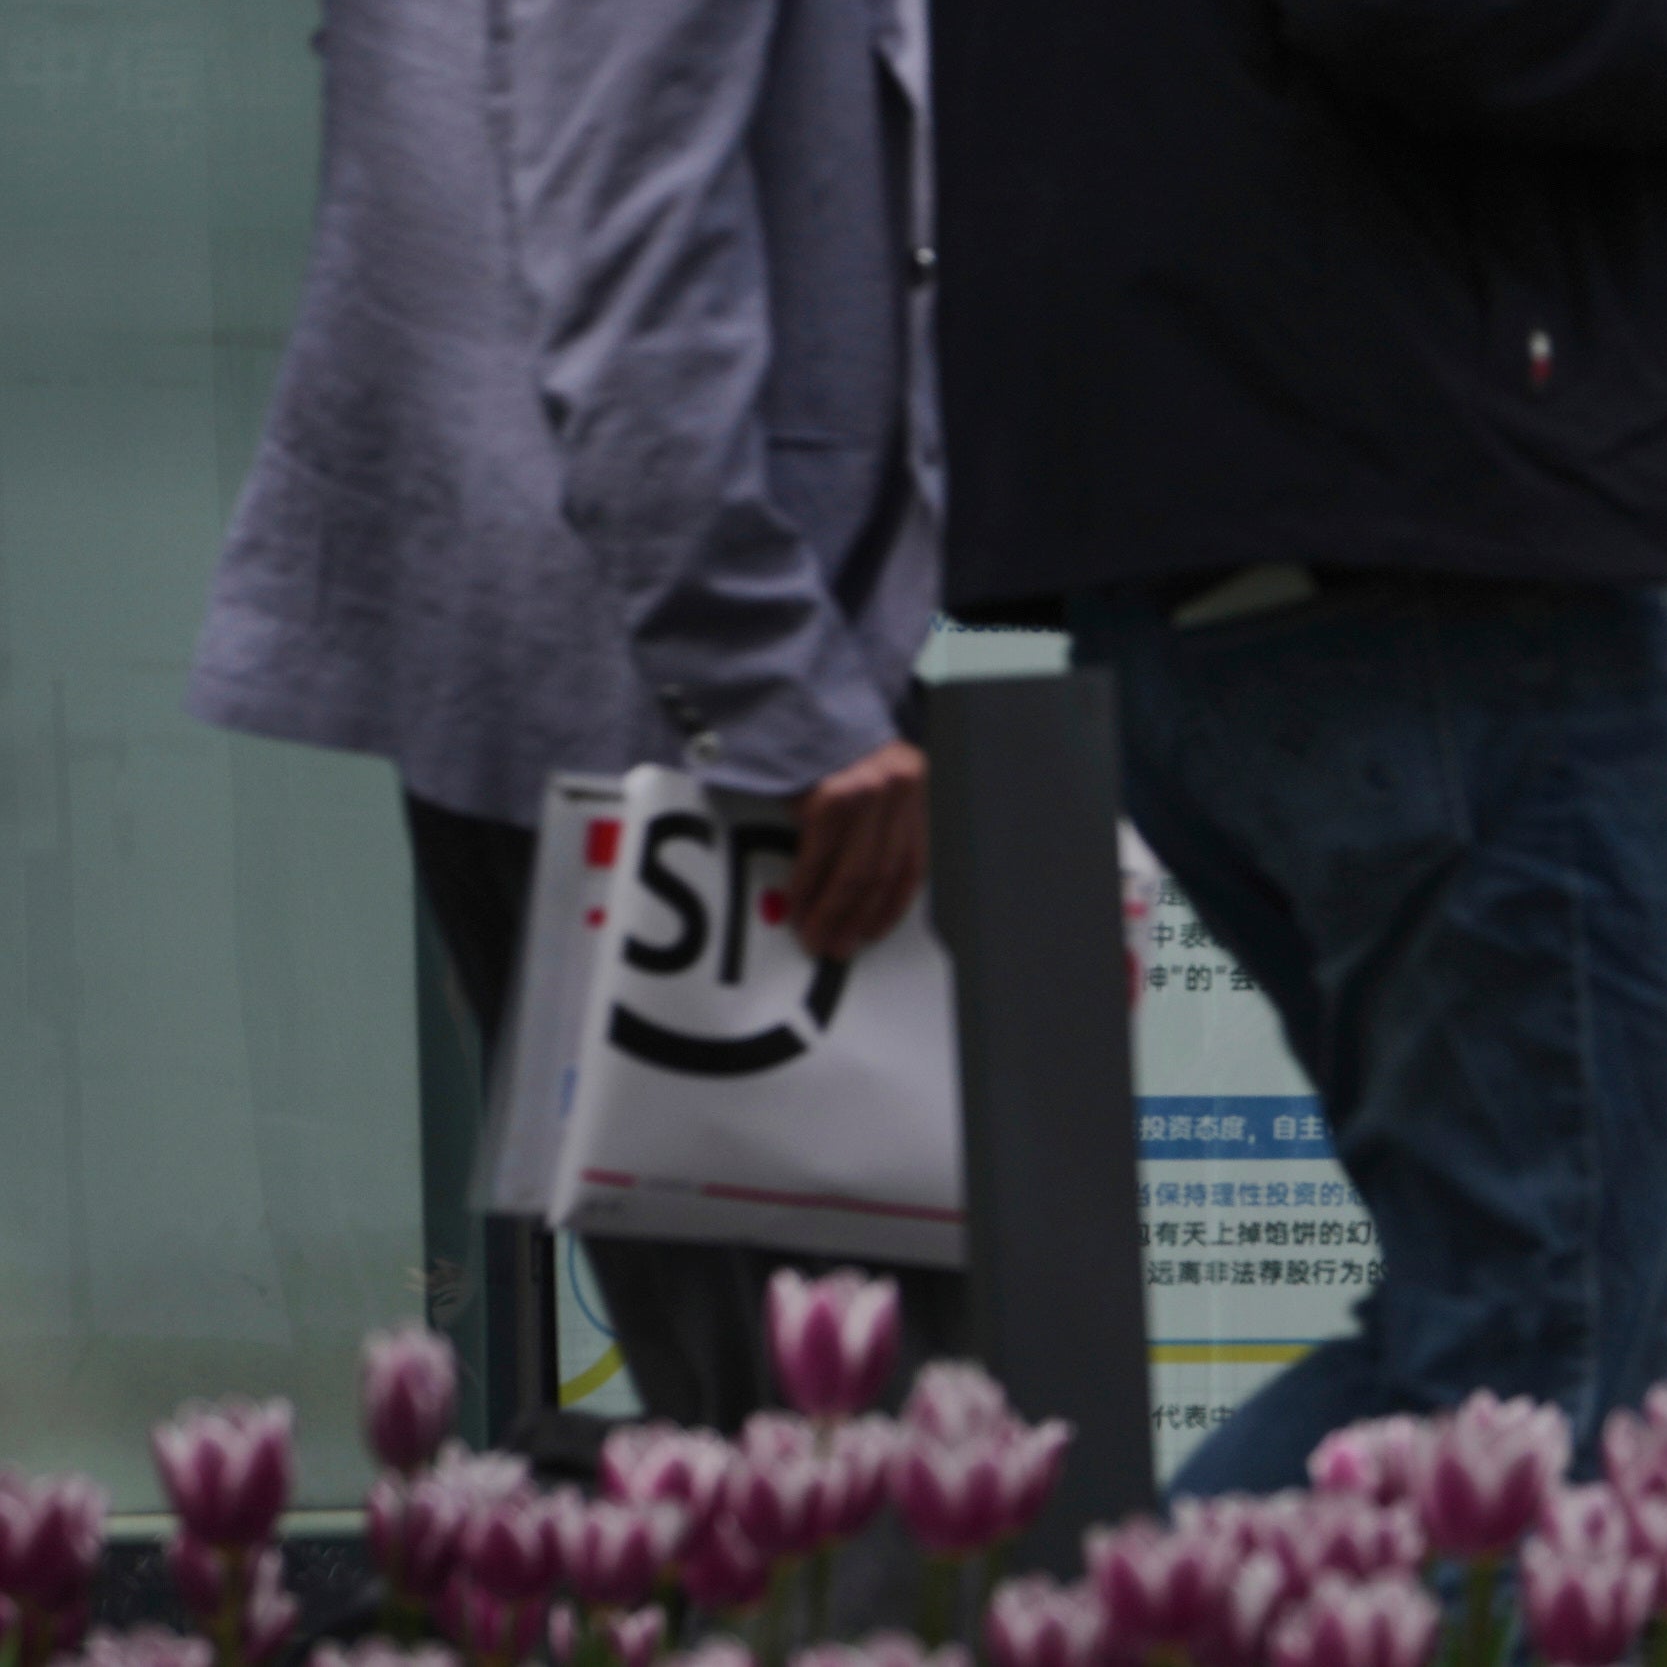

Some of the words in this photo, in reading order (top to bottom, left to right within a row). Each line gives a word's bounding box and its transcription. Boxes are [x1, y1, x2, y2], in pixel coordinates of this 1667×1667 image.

[1140, 1220, 1382, 1247] 有天上掉馅饼的幻
